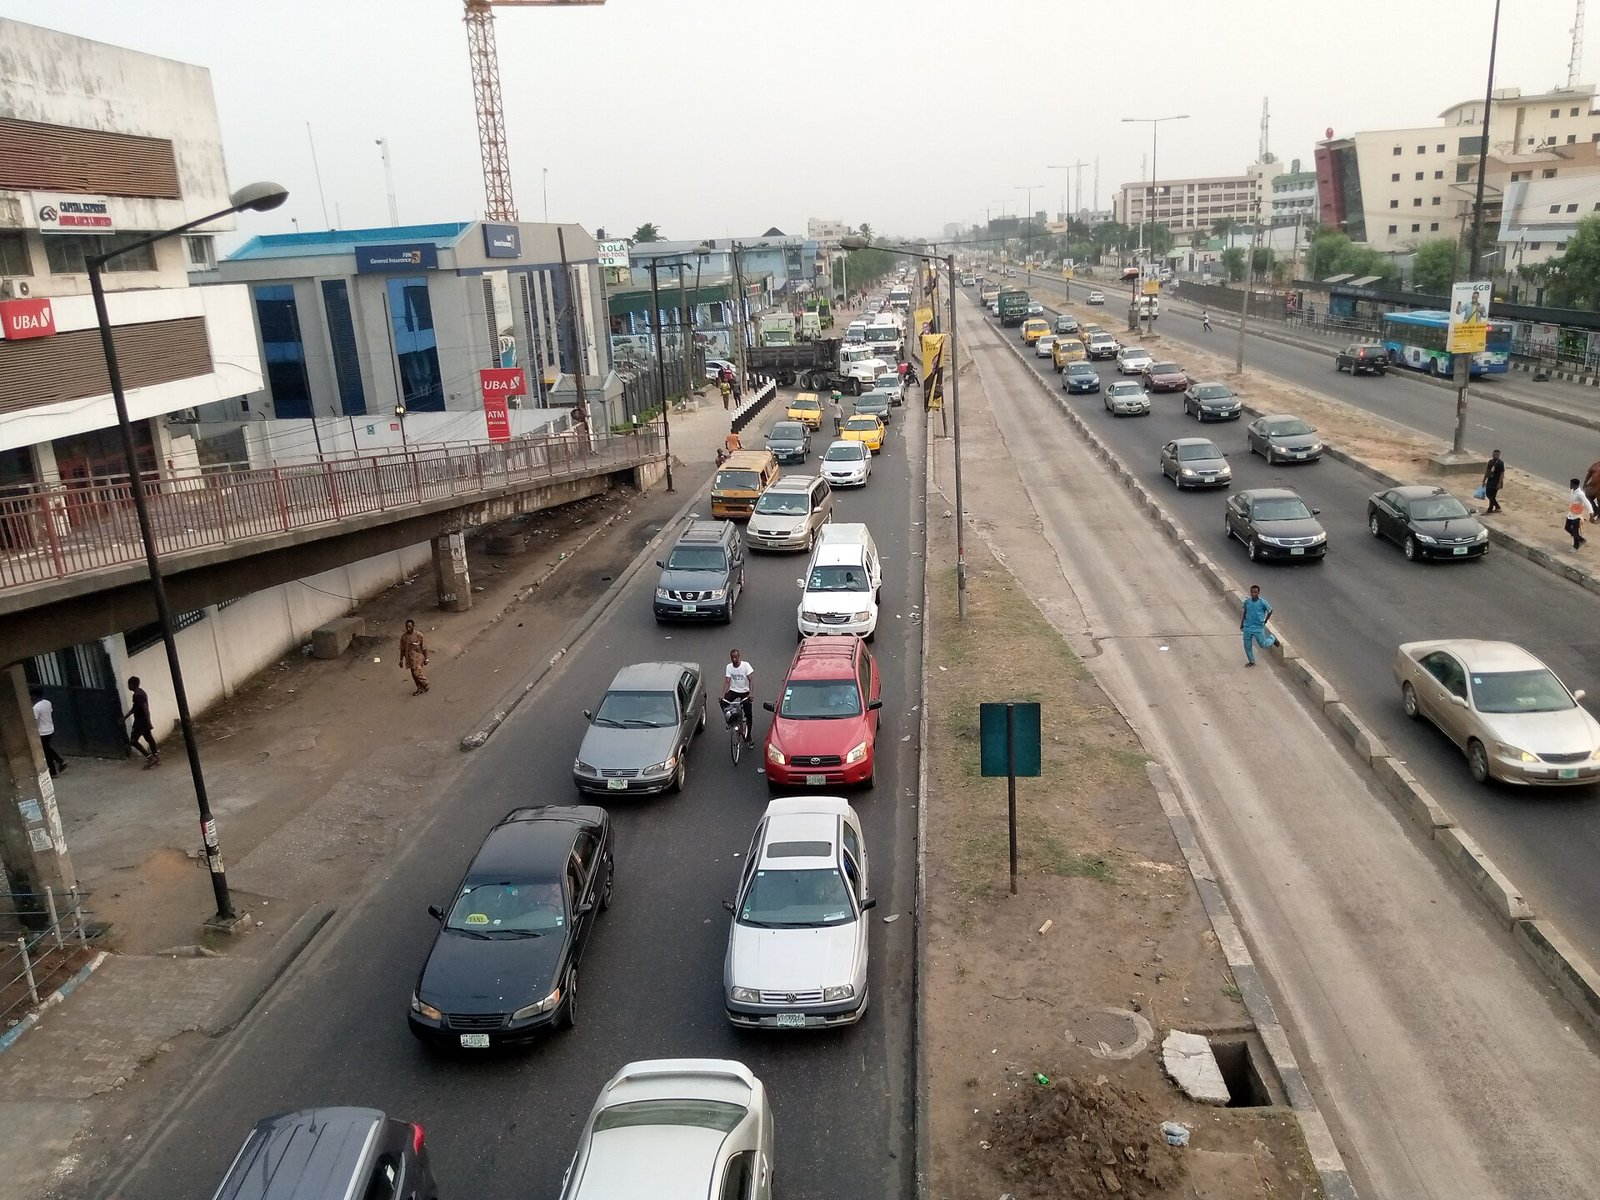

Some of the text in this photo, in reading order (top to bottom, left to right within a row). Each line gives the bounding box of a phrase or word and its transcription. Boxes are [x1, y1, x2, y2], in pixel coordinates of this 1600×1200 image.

[1473, 284, 1490, 292] 6GB
[13, 315, 40, 330] UBA
[484, 380, 508, 390] UBA
[488, 410, 505, 419] ATM
[469, 915, 485, 923] TAXI
